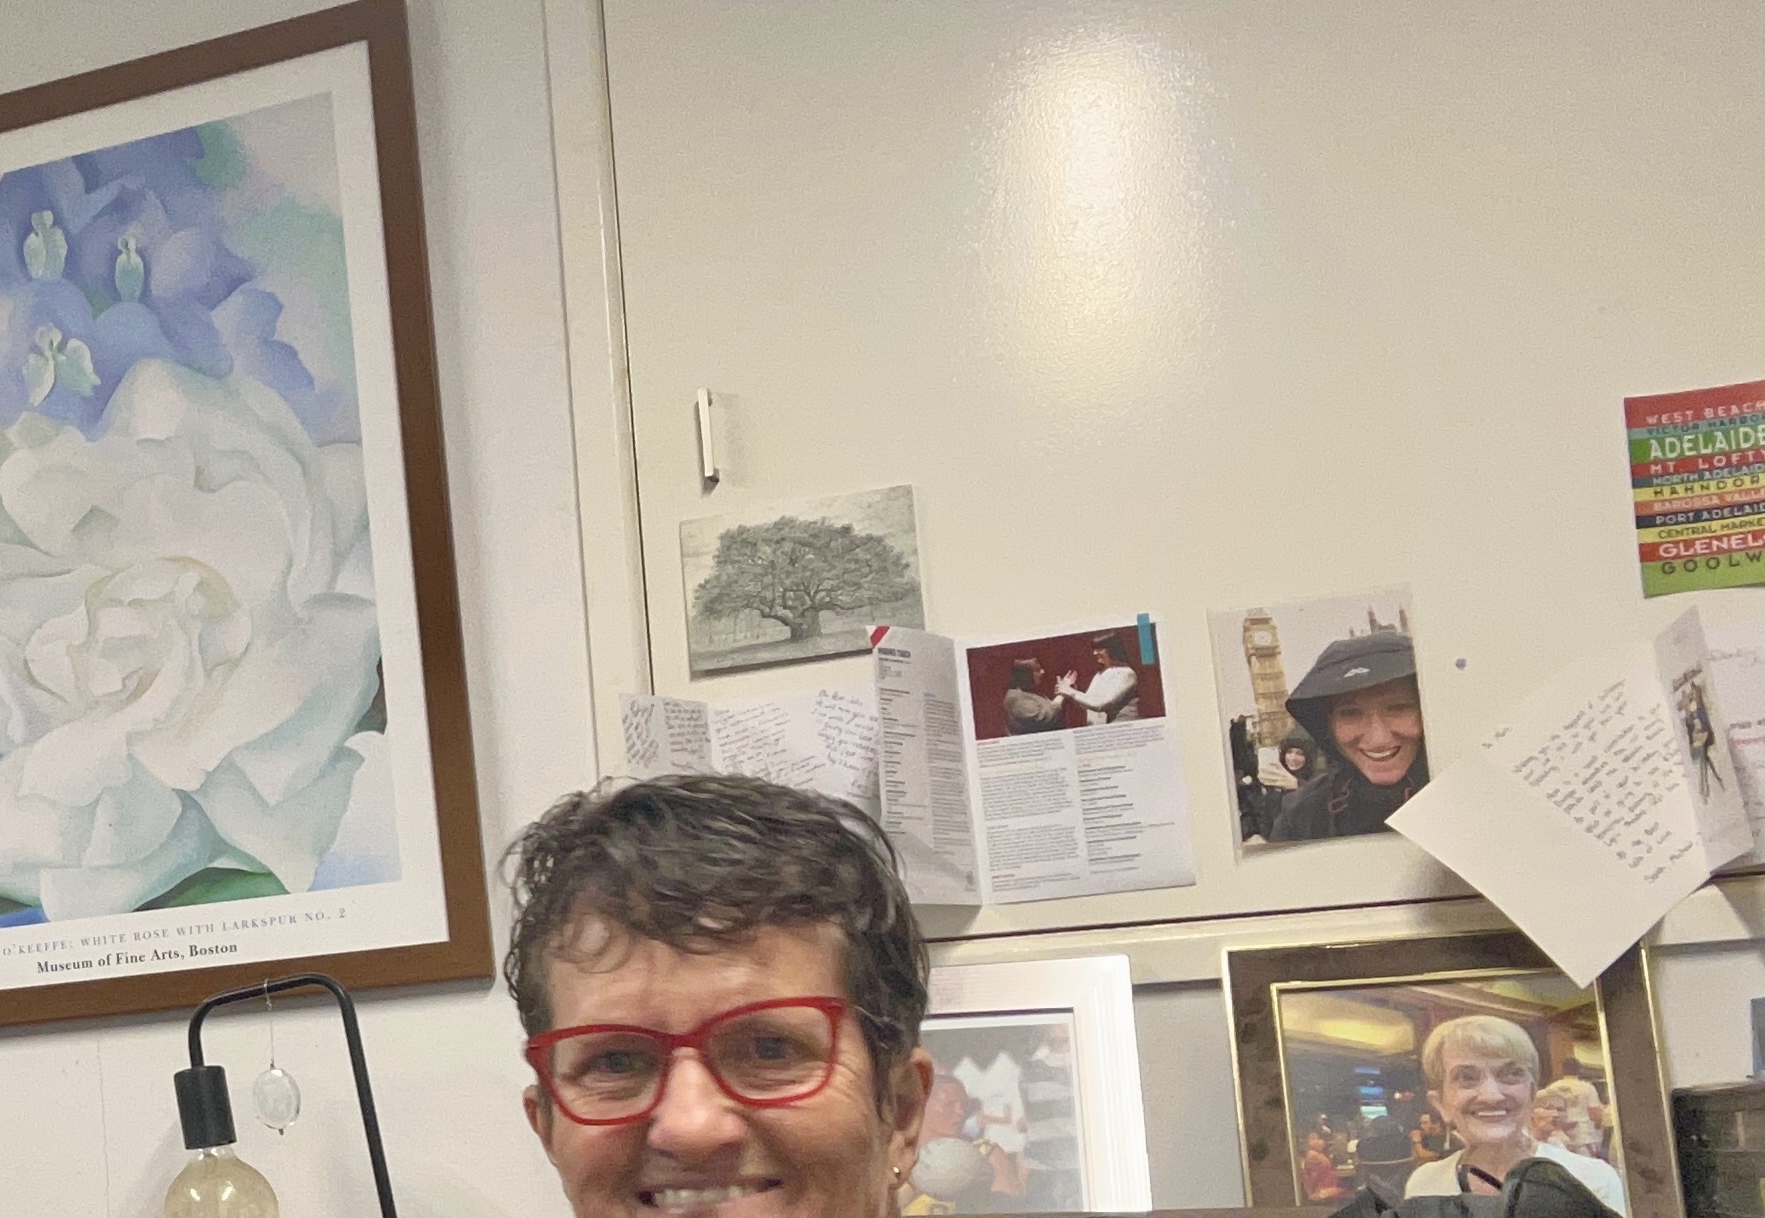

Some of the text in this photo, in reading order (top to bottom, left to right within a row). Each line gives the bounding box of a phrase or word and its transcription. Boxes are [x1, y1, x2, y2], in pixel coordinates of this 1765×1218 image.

[1646, 410, 1694, 425] WEST
[1647, 422, 1700, 435] VICTOR
[1649, 461, 1676, 475] MT
[1652, 472, 1699, 486] NORTH
[1653, 495, 1720, 511] BAROSSA
[1655, 512, 1694, 525] PORT
[1657, 525, 1716, 540] CENTRAL
[80, 933, 126, 948] WHITE
[134, 928, 169, 942] ROSE
[176, 923, 215, 937] WITH
[222, 915, 298, 932] LARKSPUR
[304, 910, 331, 922] NO.
[338, 907, 347, 919] 2
[36, 943, 239, 974] Museum of Fine Arts, Boston
